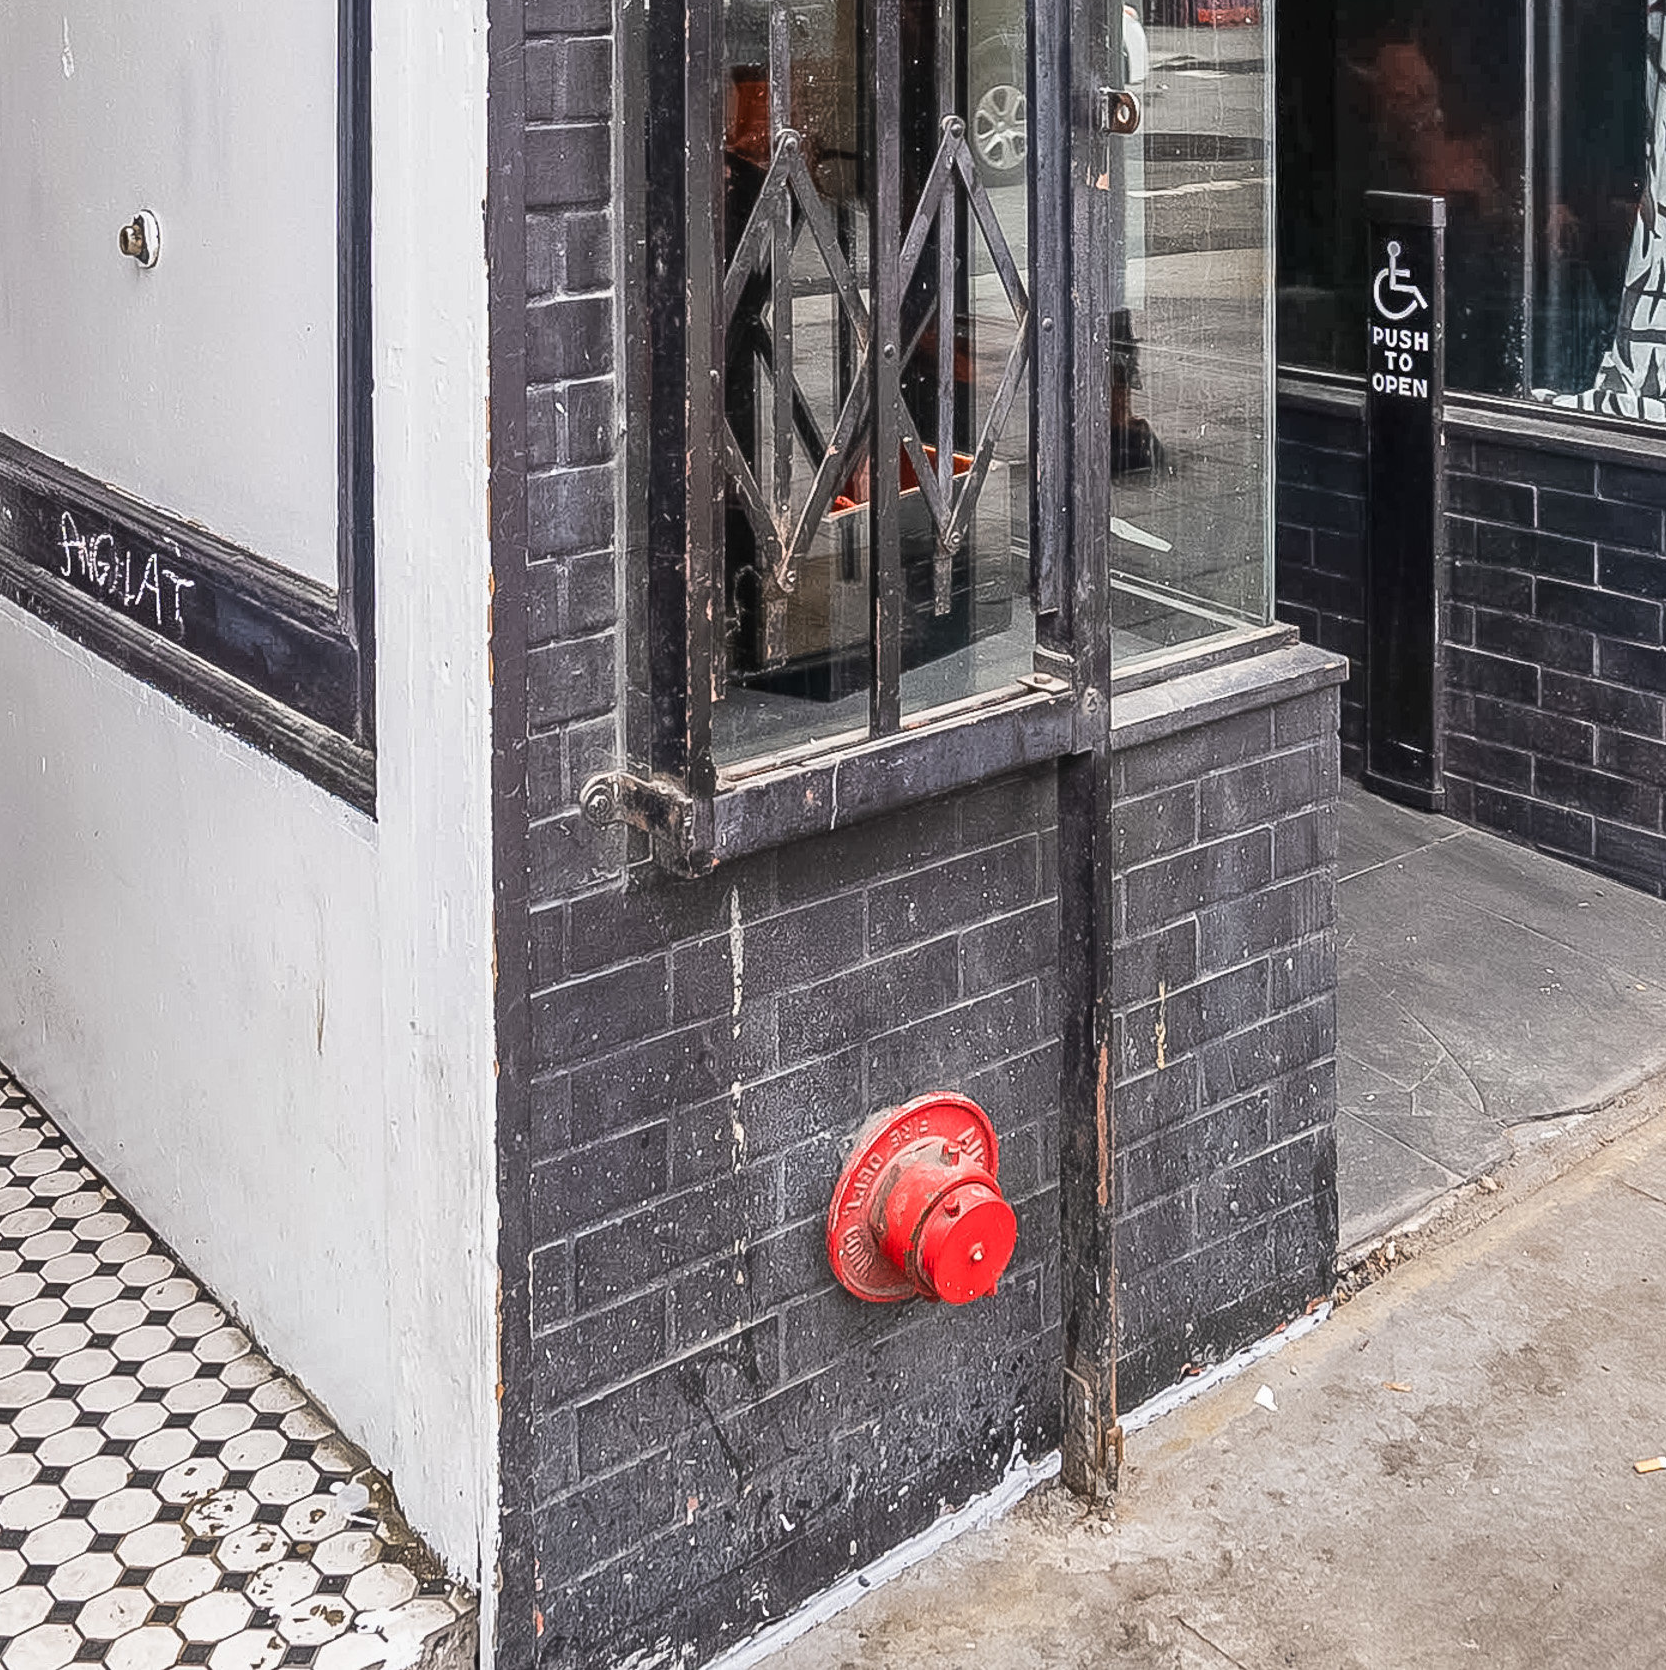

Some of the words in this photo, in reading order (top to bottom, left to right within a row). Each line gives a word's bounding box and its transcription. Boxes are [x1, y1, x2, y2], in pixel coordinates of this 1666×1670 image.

[1372, 326, 1429, 352] PUSH
[1384, 350, 1413, 372] TO
[1372, 372, 1428, 398] OPEN
